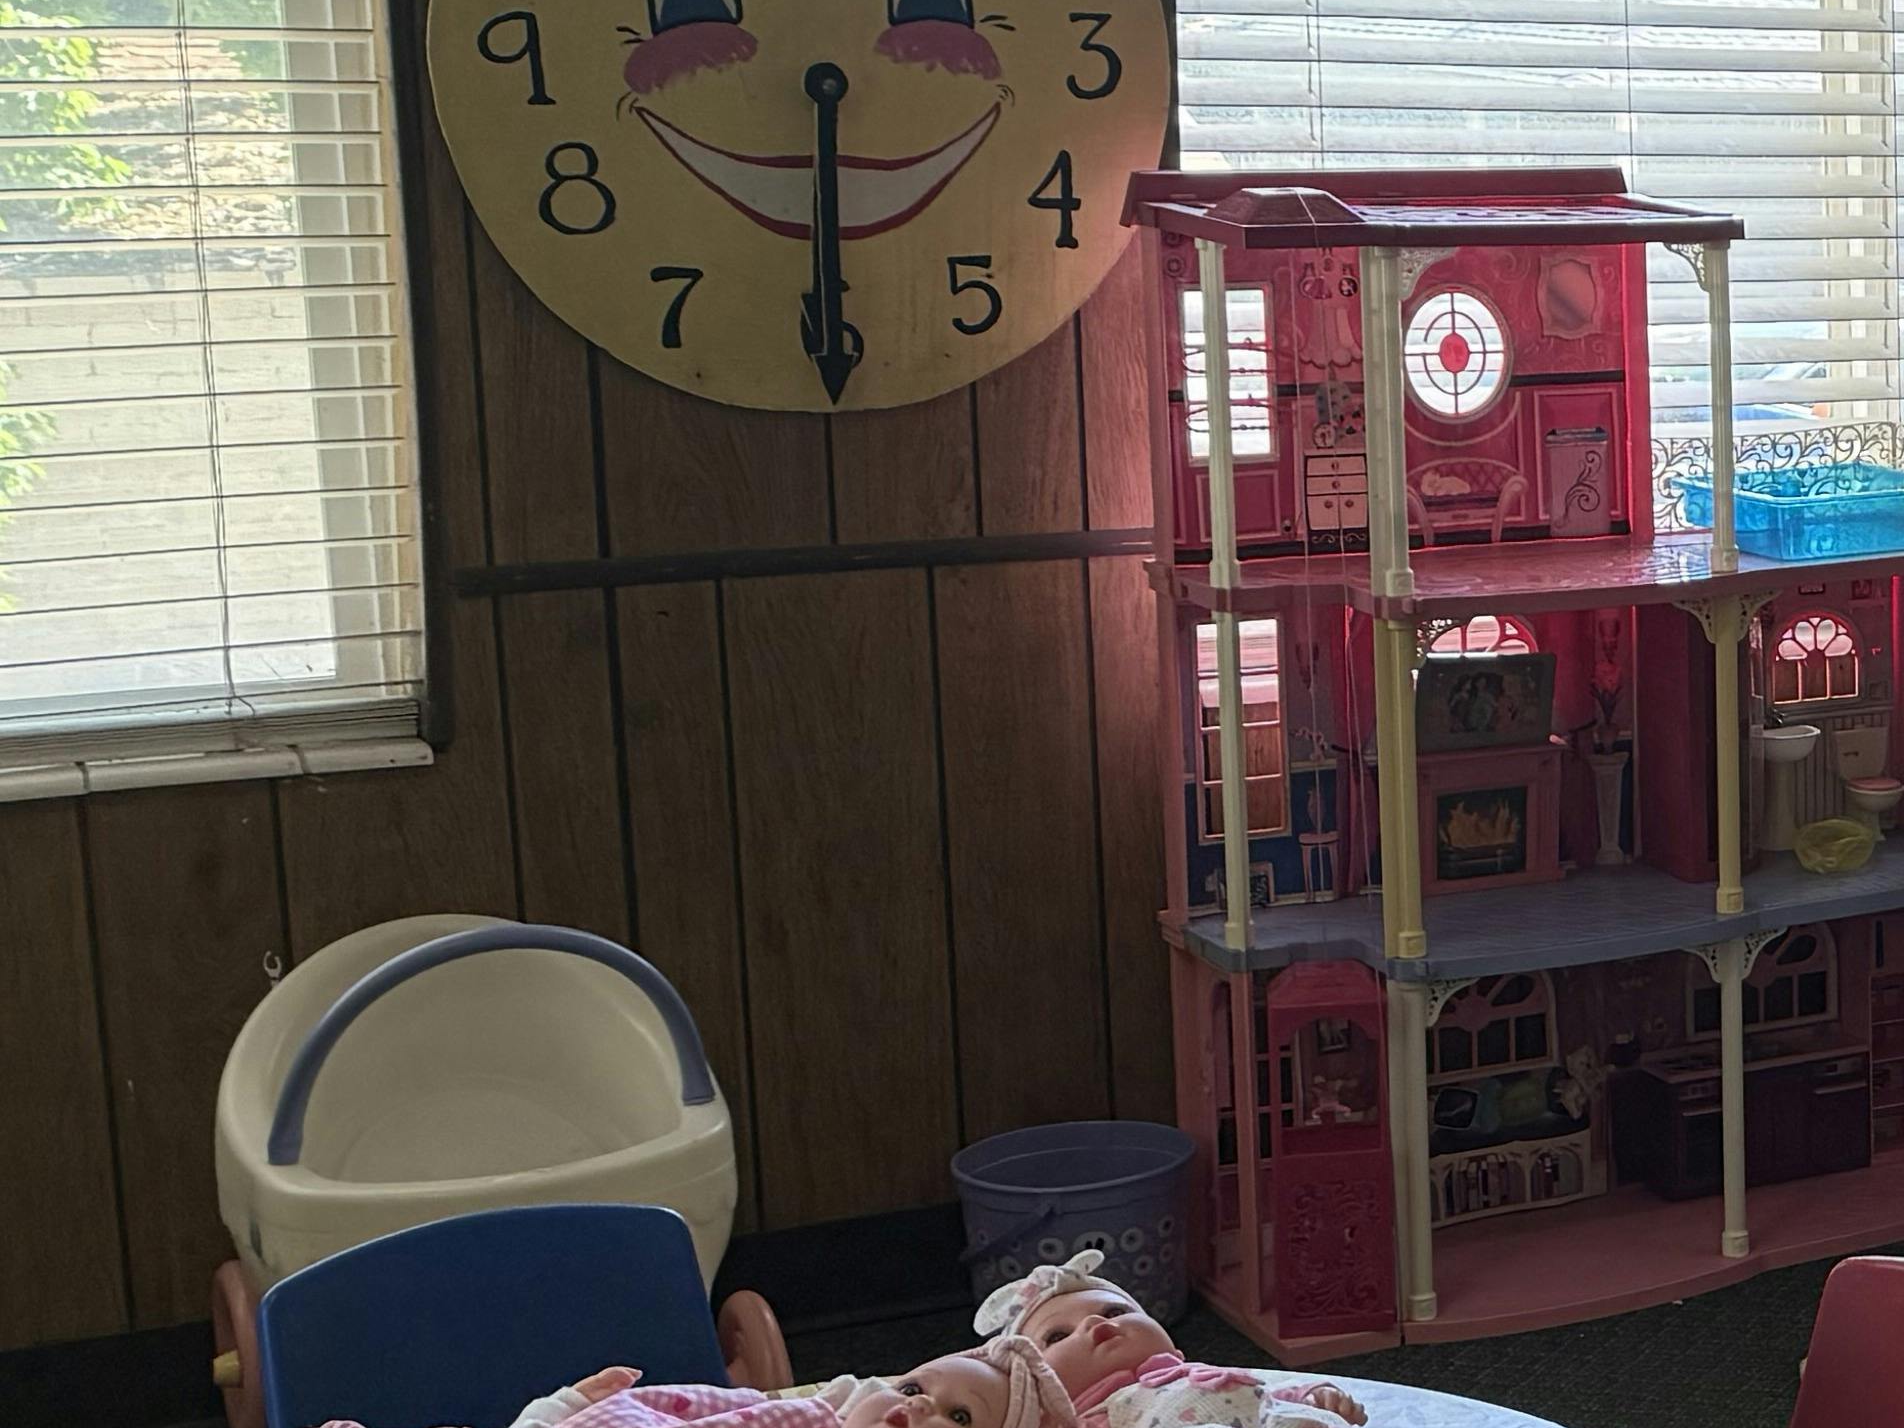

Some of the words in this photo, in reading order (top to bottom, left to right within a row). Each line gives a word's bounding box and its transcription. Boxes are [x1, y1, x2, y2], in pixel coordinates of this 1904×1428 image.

[477, 11, 557, 106] 9
[1066, 12, 1123, 99] 3
[538, 143, 617, 235] 8
[1027, 149, 1082, 249] 4
[650, 266, 704, 349] 7
[946, 255, 1003, 336] 5
